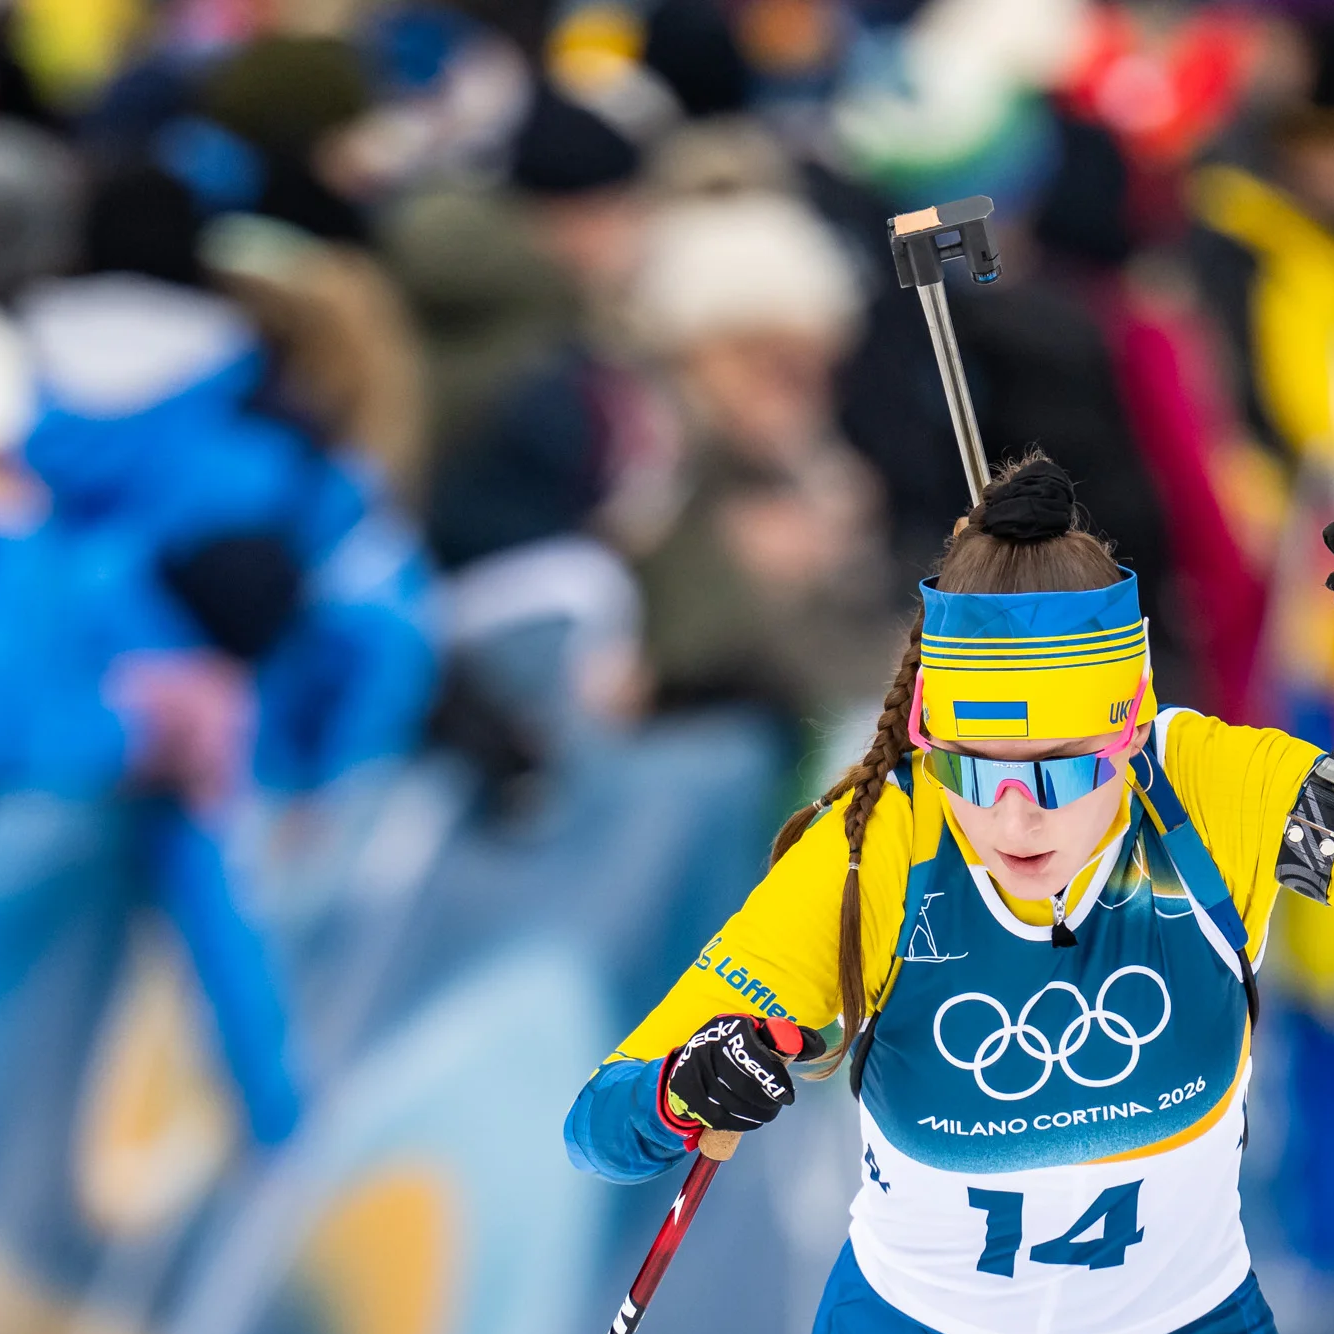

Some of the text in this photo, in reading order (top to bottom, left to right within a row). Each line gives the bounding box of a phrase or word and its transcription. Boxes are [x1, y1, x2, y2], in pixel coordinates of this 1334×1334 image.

[1109, 697, 1135, 725] UK
[917, 1075, 1207, 1137] MILANO CORTINA 2026
[966, 1178, 1145, 1278] 14
